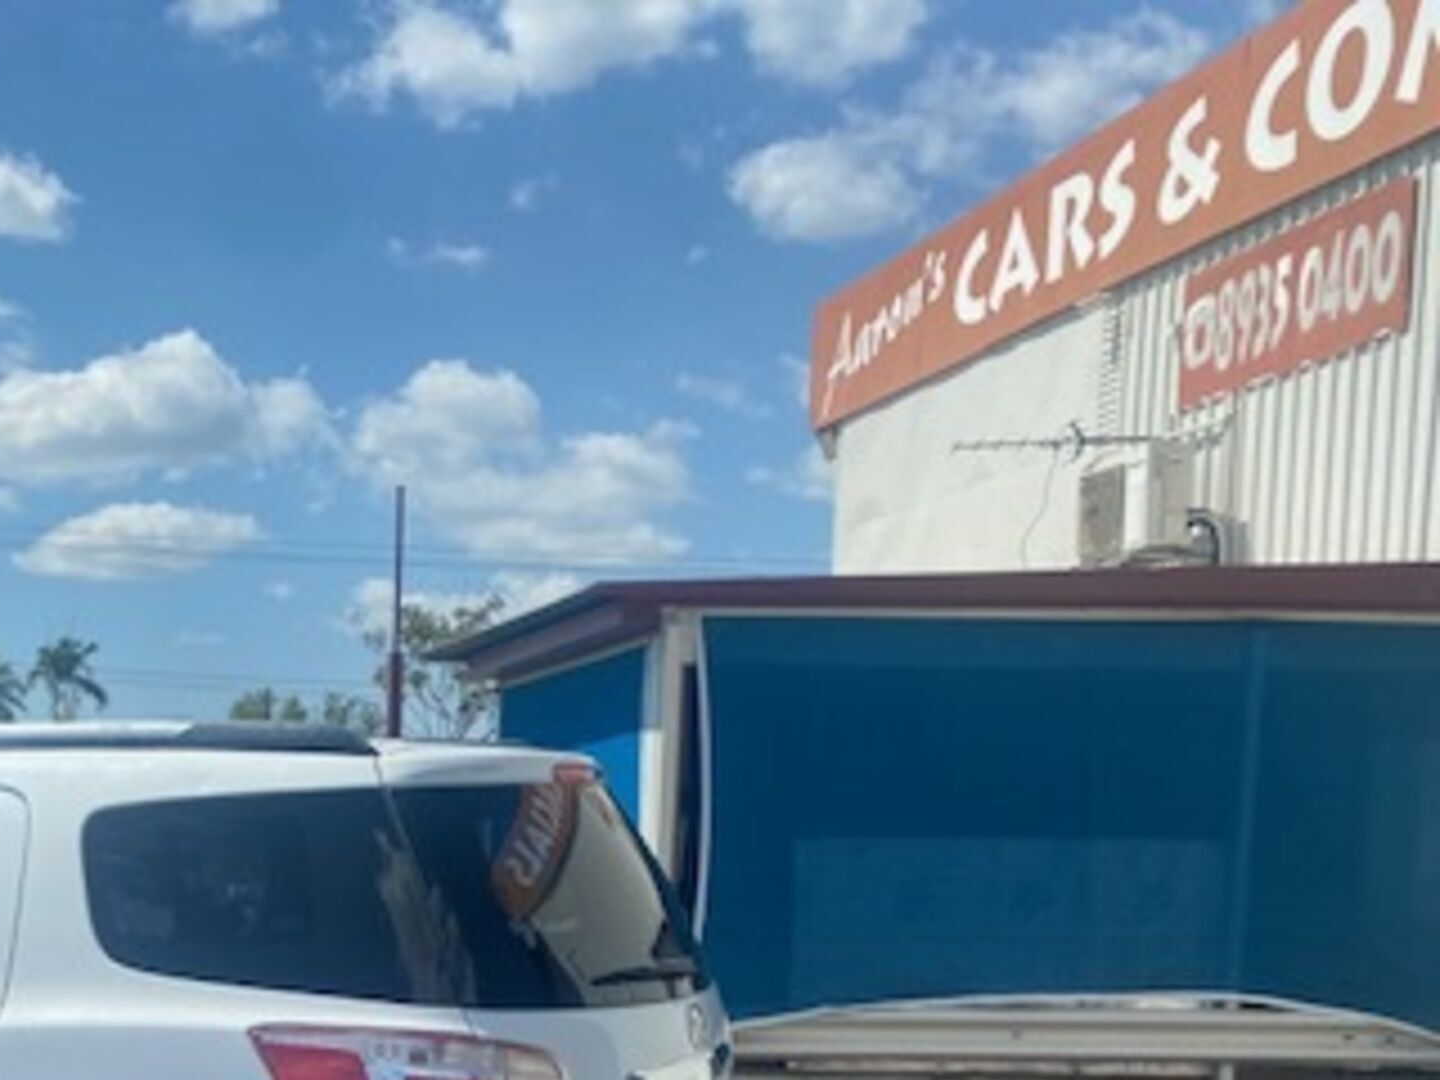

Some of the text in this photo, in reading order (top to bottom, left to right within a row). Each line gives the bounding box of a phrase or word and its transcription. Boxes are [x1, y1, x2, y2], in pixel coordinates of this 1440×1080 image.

[821, 250, 946, 420] Aaron's
[953, 139, 1136, 325] CARS
[1158, 96, 1221, 224] &
[1214, 210, 1402, 371] 8935 0400
